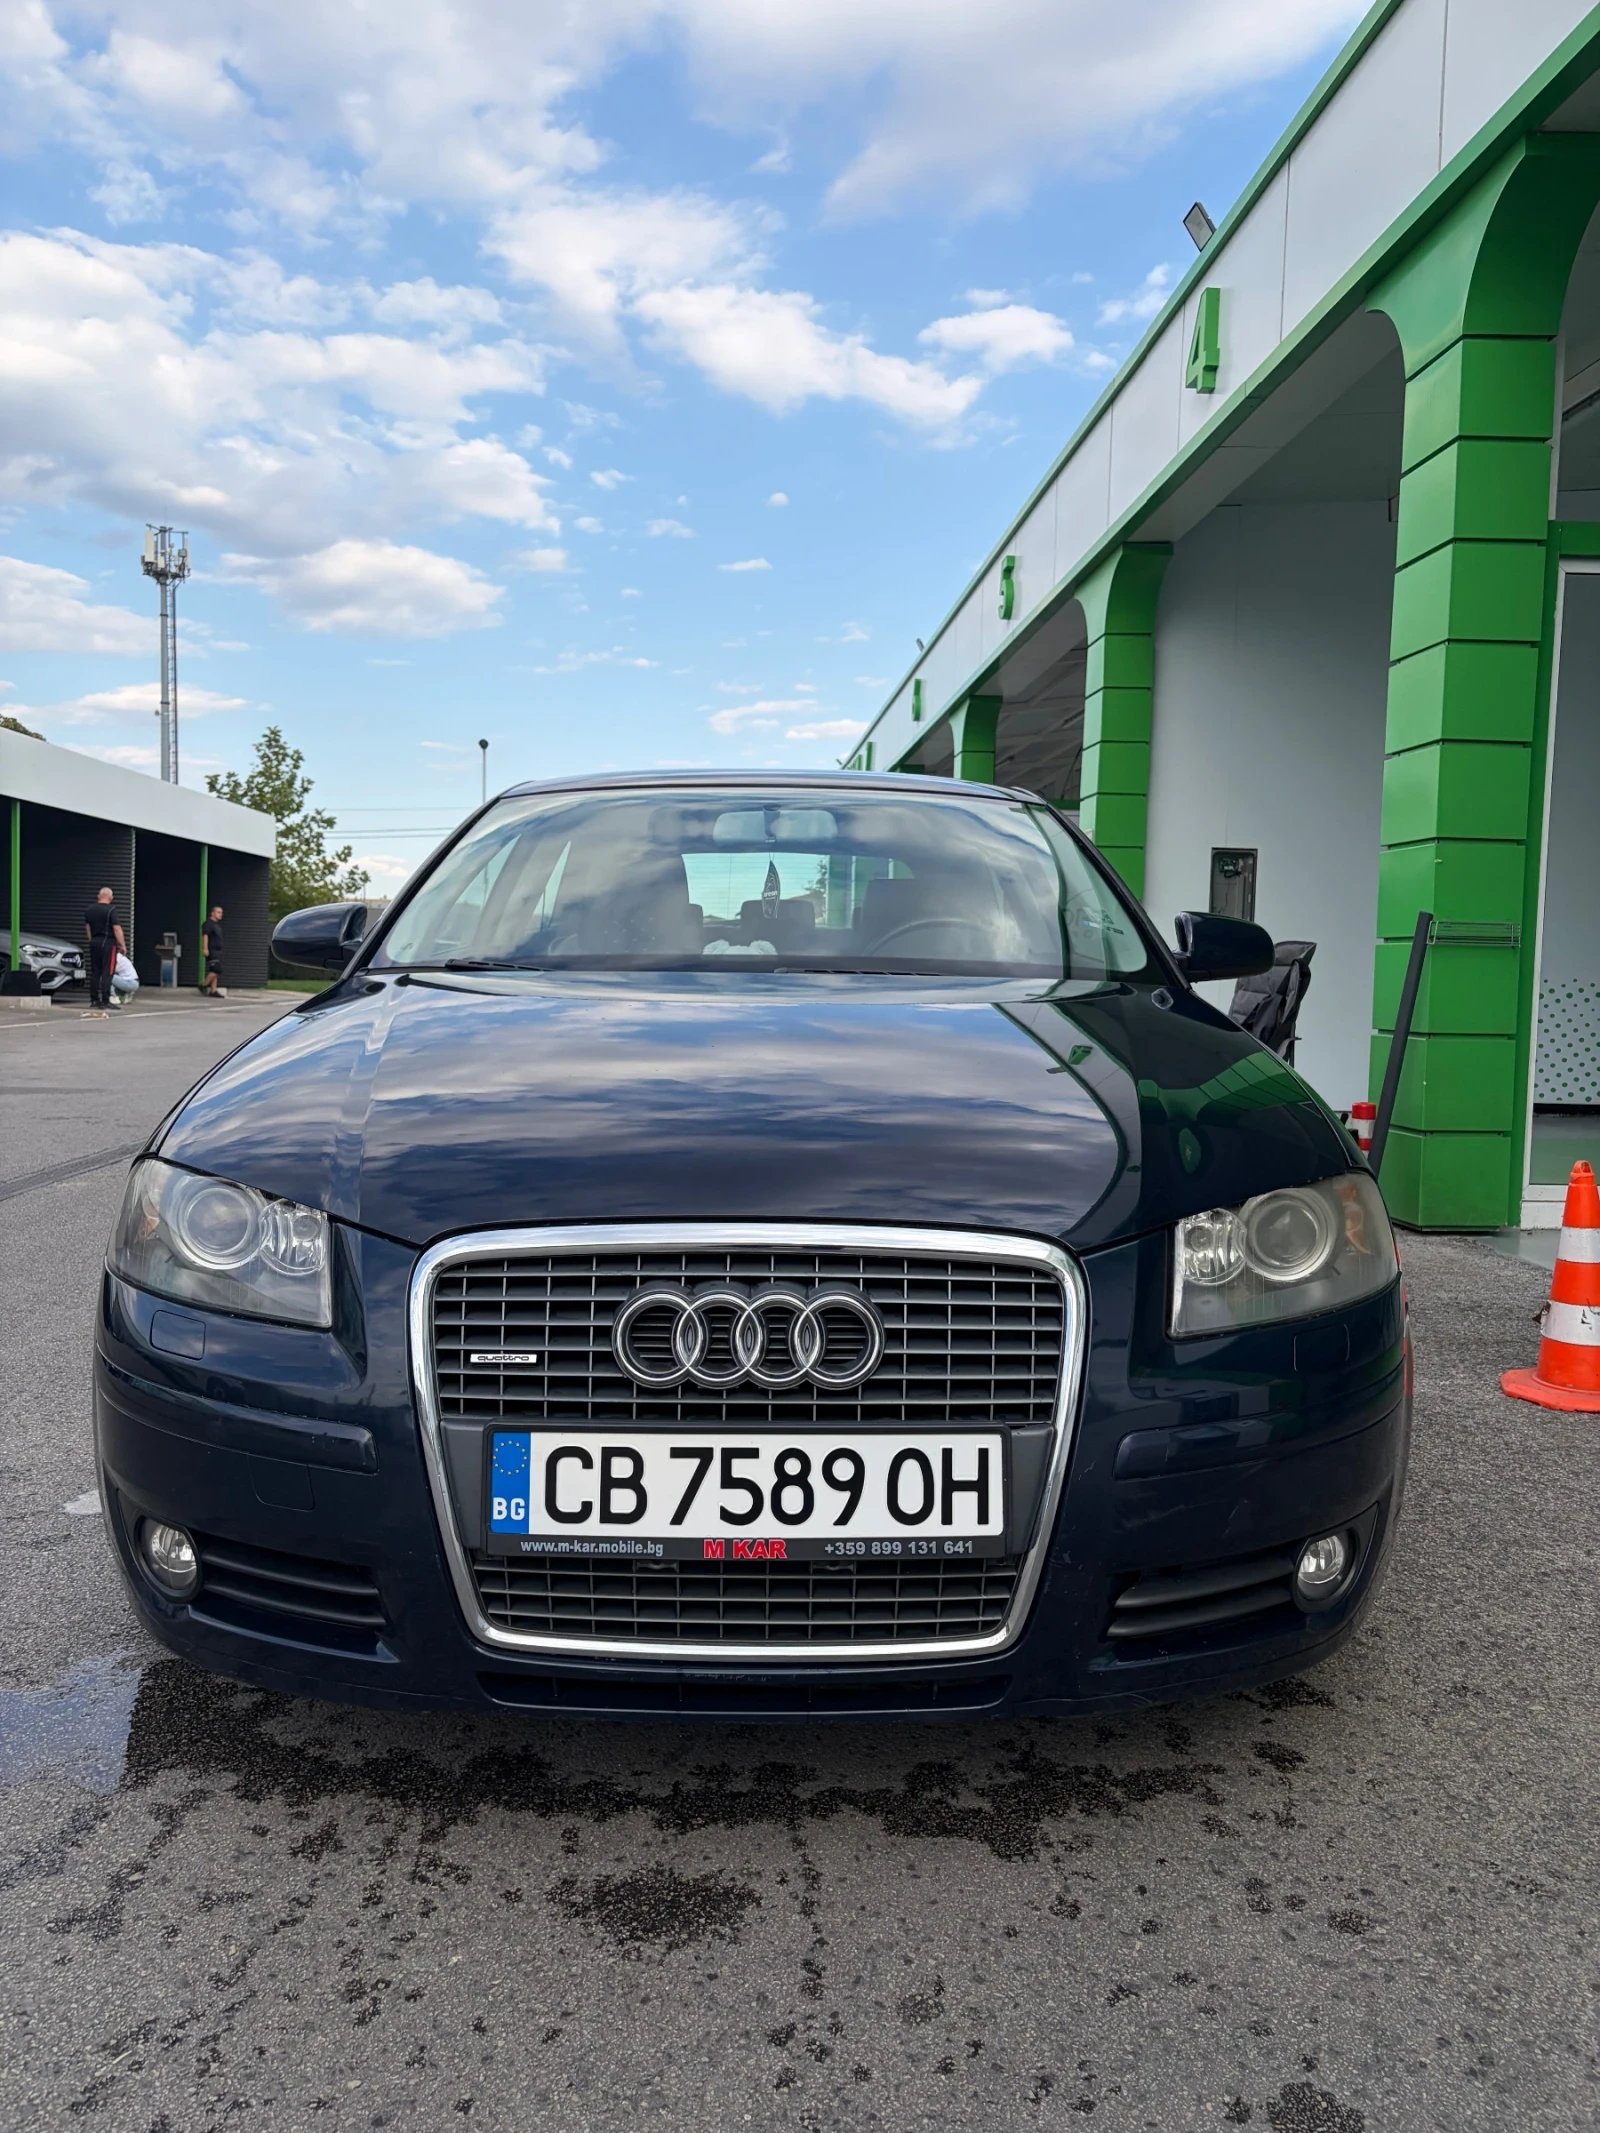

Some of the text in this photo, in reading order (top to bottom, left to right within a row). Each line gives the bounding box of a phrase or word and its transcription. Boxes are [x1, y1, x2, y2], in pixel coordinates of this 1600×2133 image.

[1186, 287, 1221, 394] 4
[545, 1446, 989, 1526] CB 7589 OH
[492, 1497, 525, 1520] BG
[520, 1540, 664, 1556] www.m-kar.mobile.bg
[703, 1539, 788, 1559] M KAR
[824, 1541, 973, 1555] +359 899 131 641
